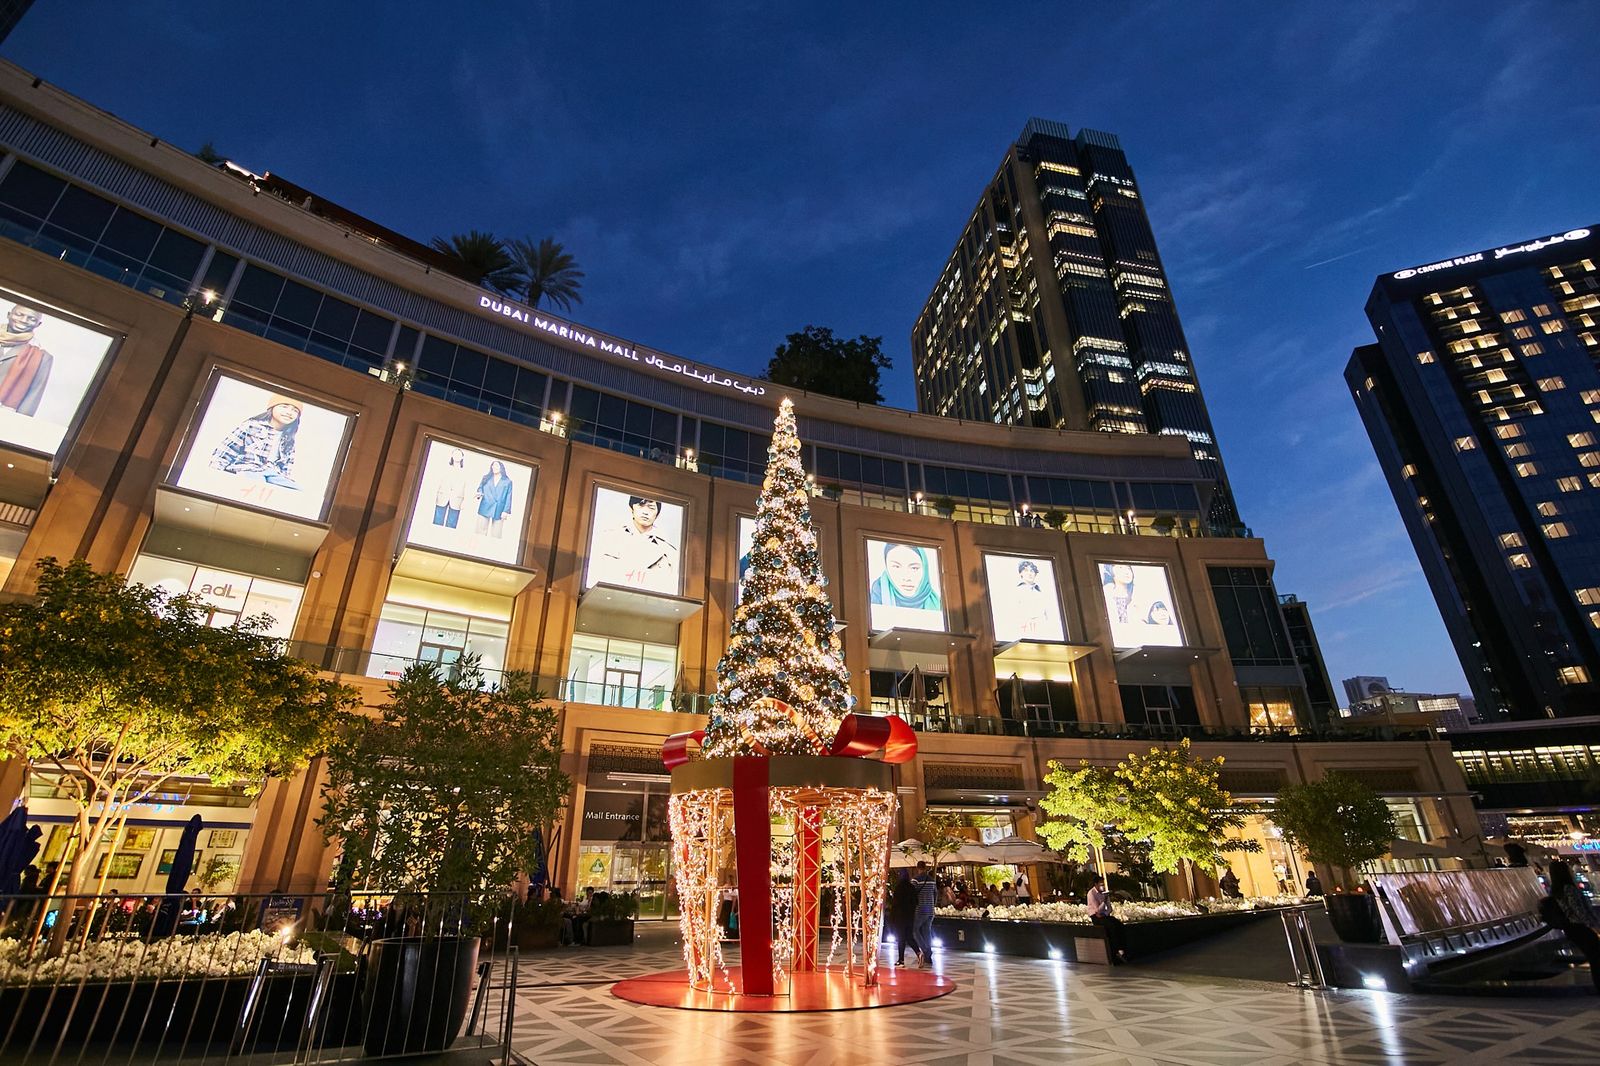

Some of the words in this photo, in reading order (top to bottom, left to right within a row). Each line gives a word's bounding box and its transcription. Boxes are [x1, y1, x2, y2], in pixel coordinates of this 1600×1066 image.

[1417, 260, 1453, 274] CROWNE
[1454, 253, 1484, 266] PLAZA
[480, 296, 529, 323] DUBAI
[534, 317, 596, 348] MARINA
[600, 340, 639, 361] MALL
[645, 355, 682, 373] مول
[682, 364, 732, 387] مارينا
[733, 379, 765, 396] دبي
[585, 811, 604, 820] Mall
[605, 811, 640, 821] Entrance
